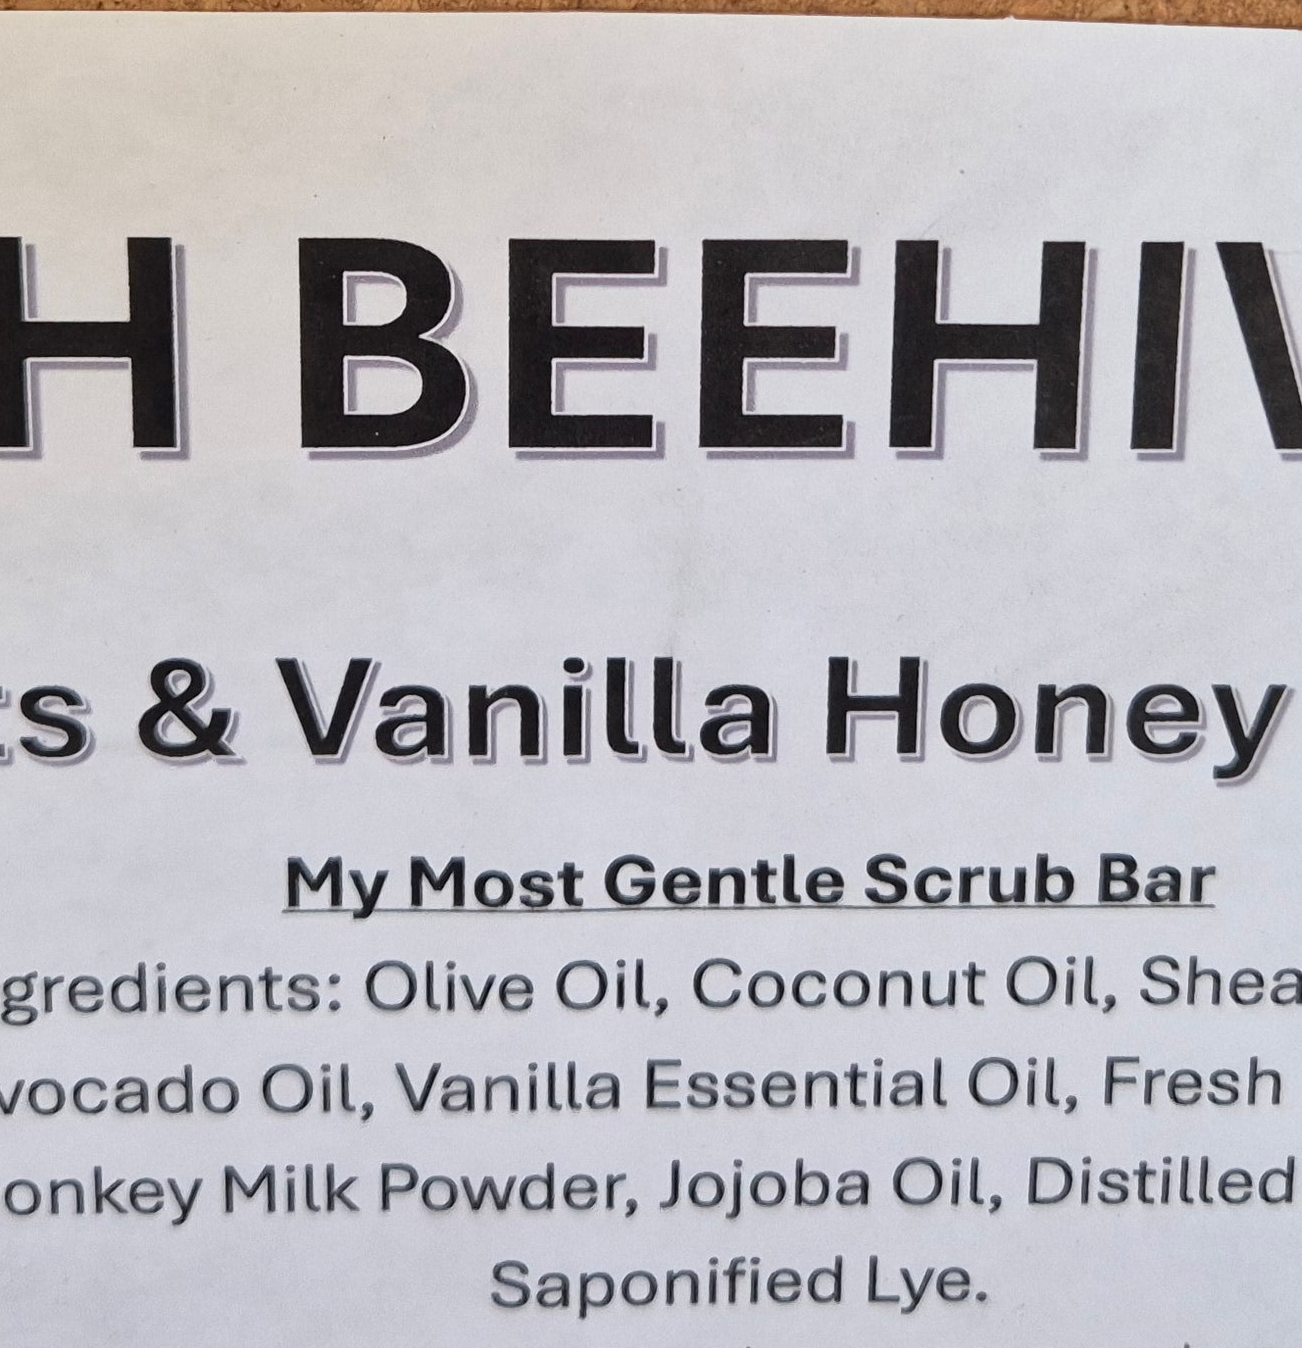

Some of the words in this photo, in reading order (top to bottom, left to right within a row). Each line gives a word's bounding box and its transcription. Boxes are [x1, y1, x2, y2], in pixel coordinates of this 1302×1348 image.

[138, 658, 237, 764] &
[276, 657, 777, 764] Vanilla
[826, 657, 1290, 784] Honey
[284, 855, 388, 920] My
[409, 855, 584, 909] Most
[603, 853, 845, 908] Gentle
[864, 852, 1076, 906] Scrub
[1097, 852, 1216, 904] Bar
[363, 958, 534, 1015] Olive
[554, 957, 670, 1020] Oil,
[691, 956, 988, 1011] Coconut
[1005, 954, 1118, 1017] Oil,
[260, 1061, 375, 1125] Oil,
[393, 1059, 622, 1115] Vanilla
[644, 1056, 949, 1112] Essential
[967, 1055, 1079, 1116] Oil,
[1102, 1054, 1283, 1108] Fresh
[222, 1161, 361, 1216] Milk
[379, 1160, 640, 1221] Powder,
[658, 1156, 871, 1223] Jojoba
[891, 1155, 1004, 1216] Oil,
[1026, 1154, 1297, 1208] Distilled
[489, 1253, 844, 1322] Saponified
[866, 1253, 989, 1317] Lye.
